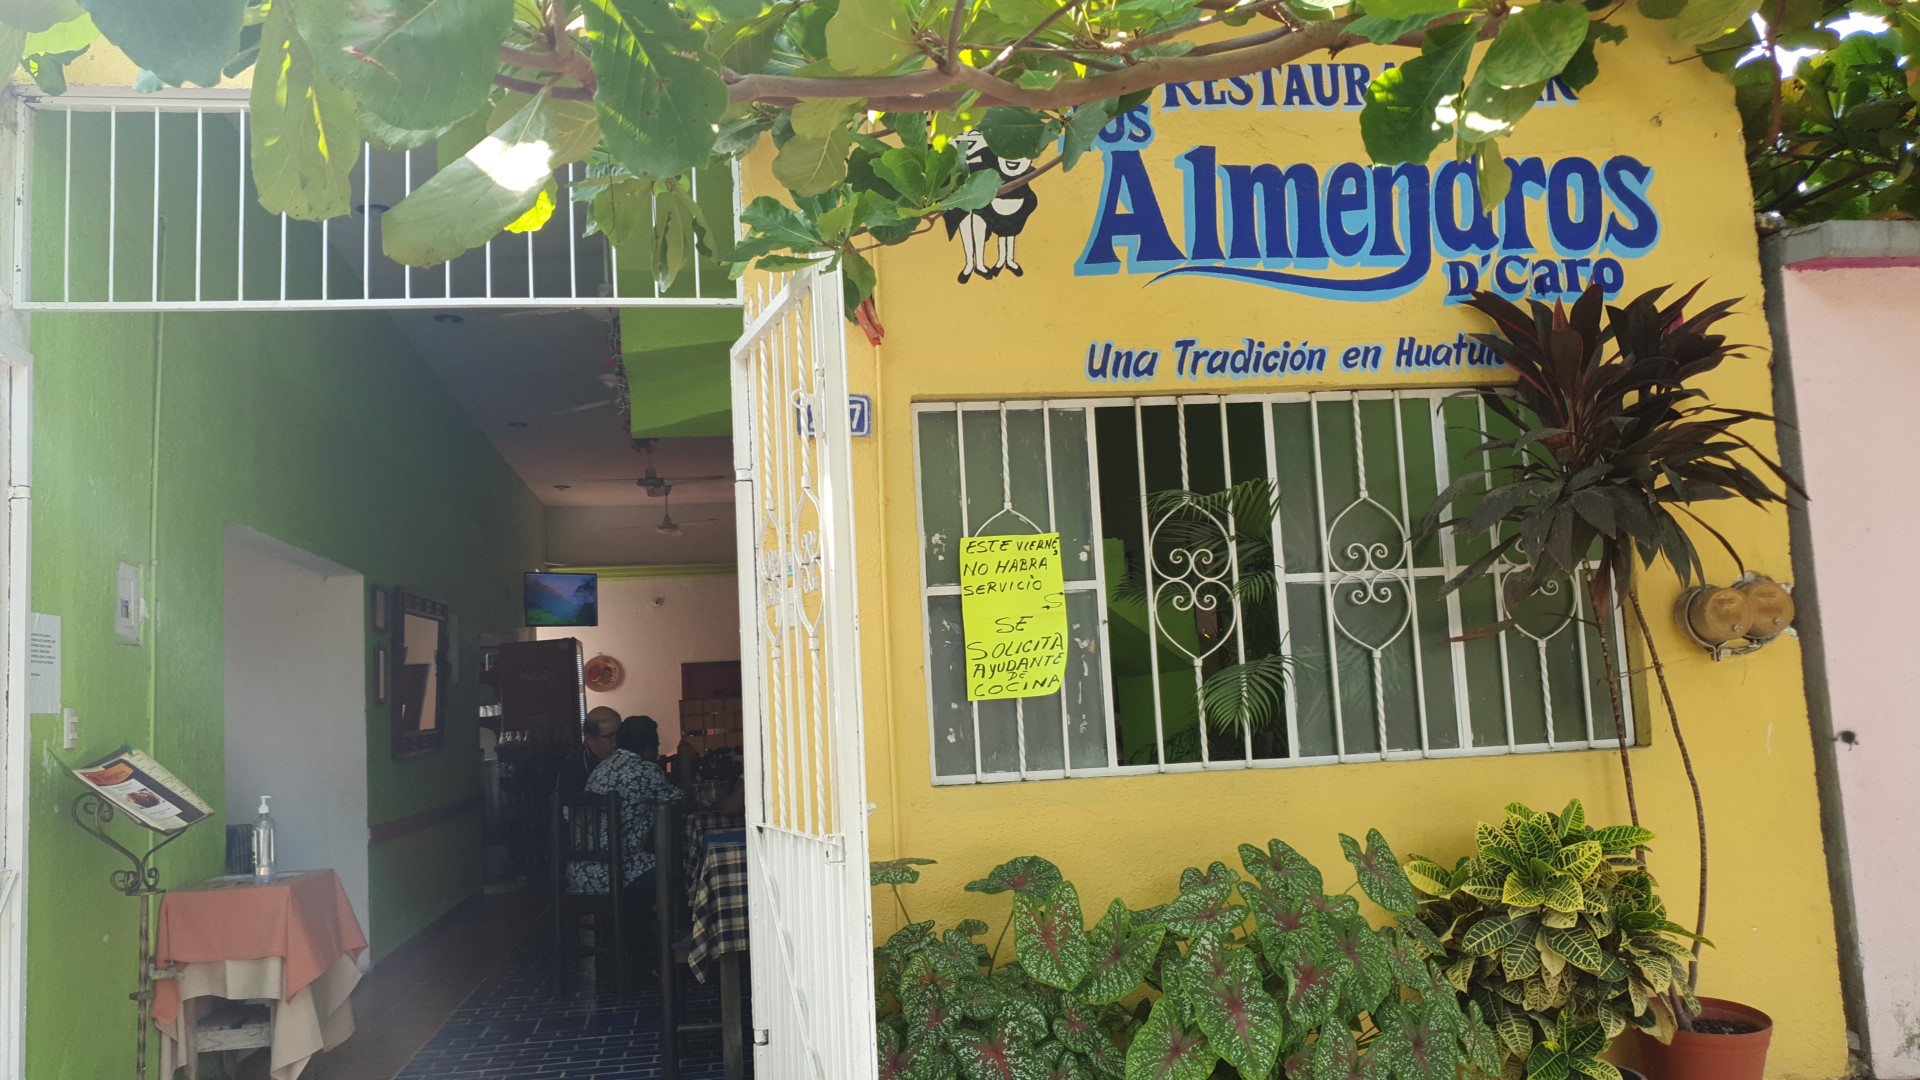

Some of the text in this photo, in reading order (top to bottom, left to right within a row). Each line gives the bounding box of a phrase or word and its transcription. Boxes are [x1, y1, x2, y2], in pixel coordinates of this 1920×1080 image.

[1160, 63, 1399, 112] RESTAUR
[1444, 252, 1626, 301] D'Caro
[1086, 341, 1160, 382] Una
[1173, 337, 1328, 381] Tradición
[1340, 343, 1385, 373] en
[965, 539, 1012, 555] ESTE
[963, 556, 1048, 577] NO HABRA
[963, 575, 1043, 597] SERVICIO
[995, 616, 1033, 634] SE
[967, 632, 1063, 661] SOLICITA
[973, 652, 1065, 680] AYUDANTE
[1007, 671, 1029, 681] DE
[974, 674, 1060, 697] COCINA
